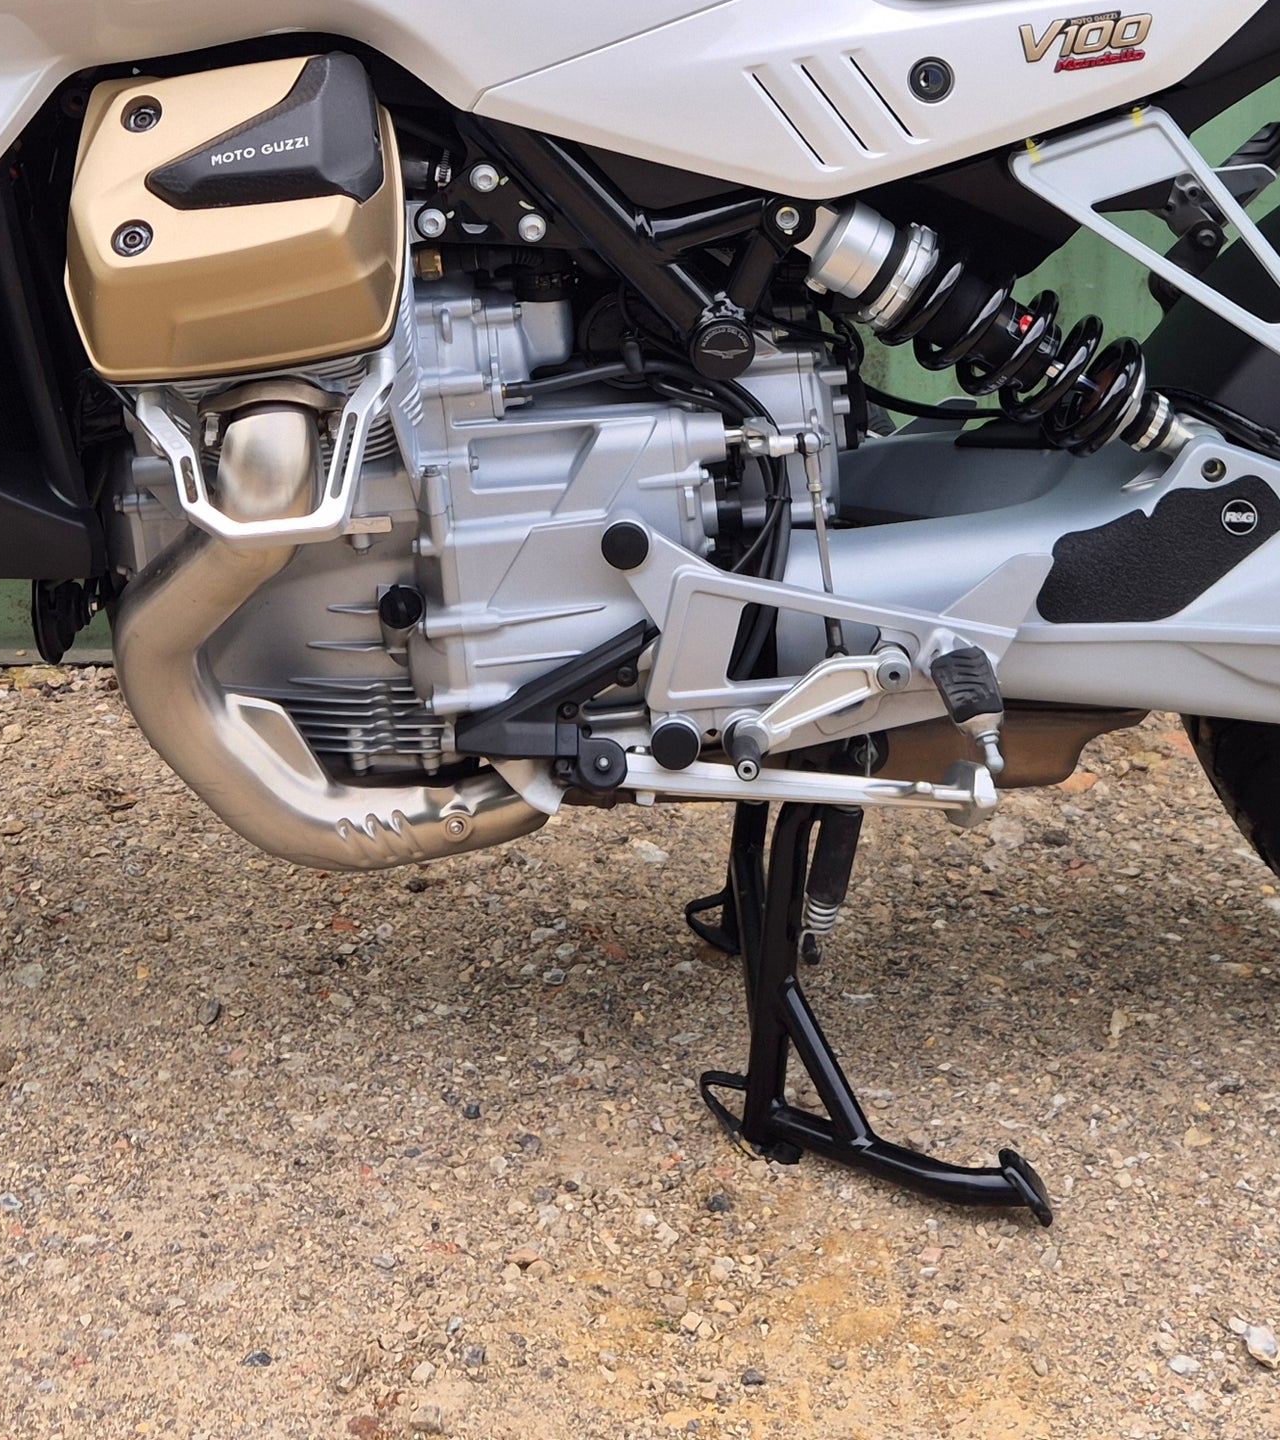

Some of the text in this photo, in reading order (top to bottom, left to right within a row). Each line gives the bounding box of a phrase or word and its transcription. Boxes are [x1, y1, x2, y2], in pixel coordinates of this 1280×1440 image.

[1019, 13, 1152, 63] V100
[211, 136, 309, 166] MOTO GUZZI
[1225, 511, 1255, 523] R&G
